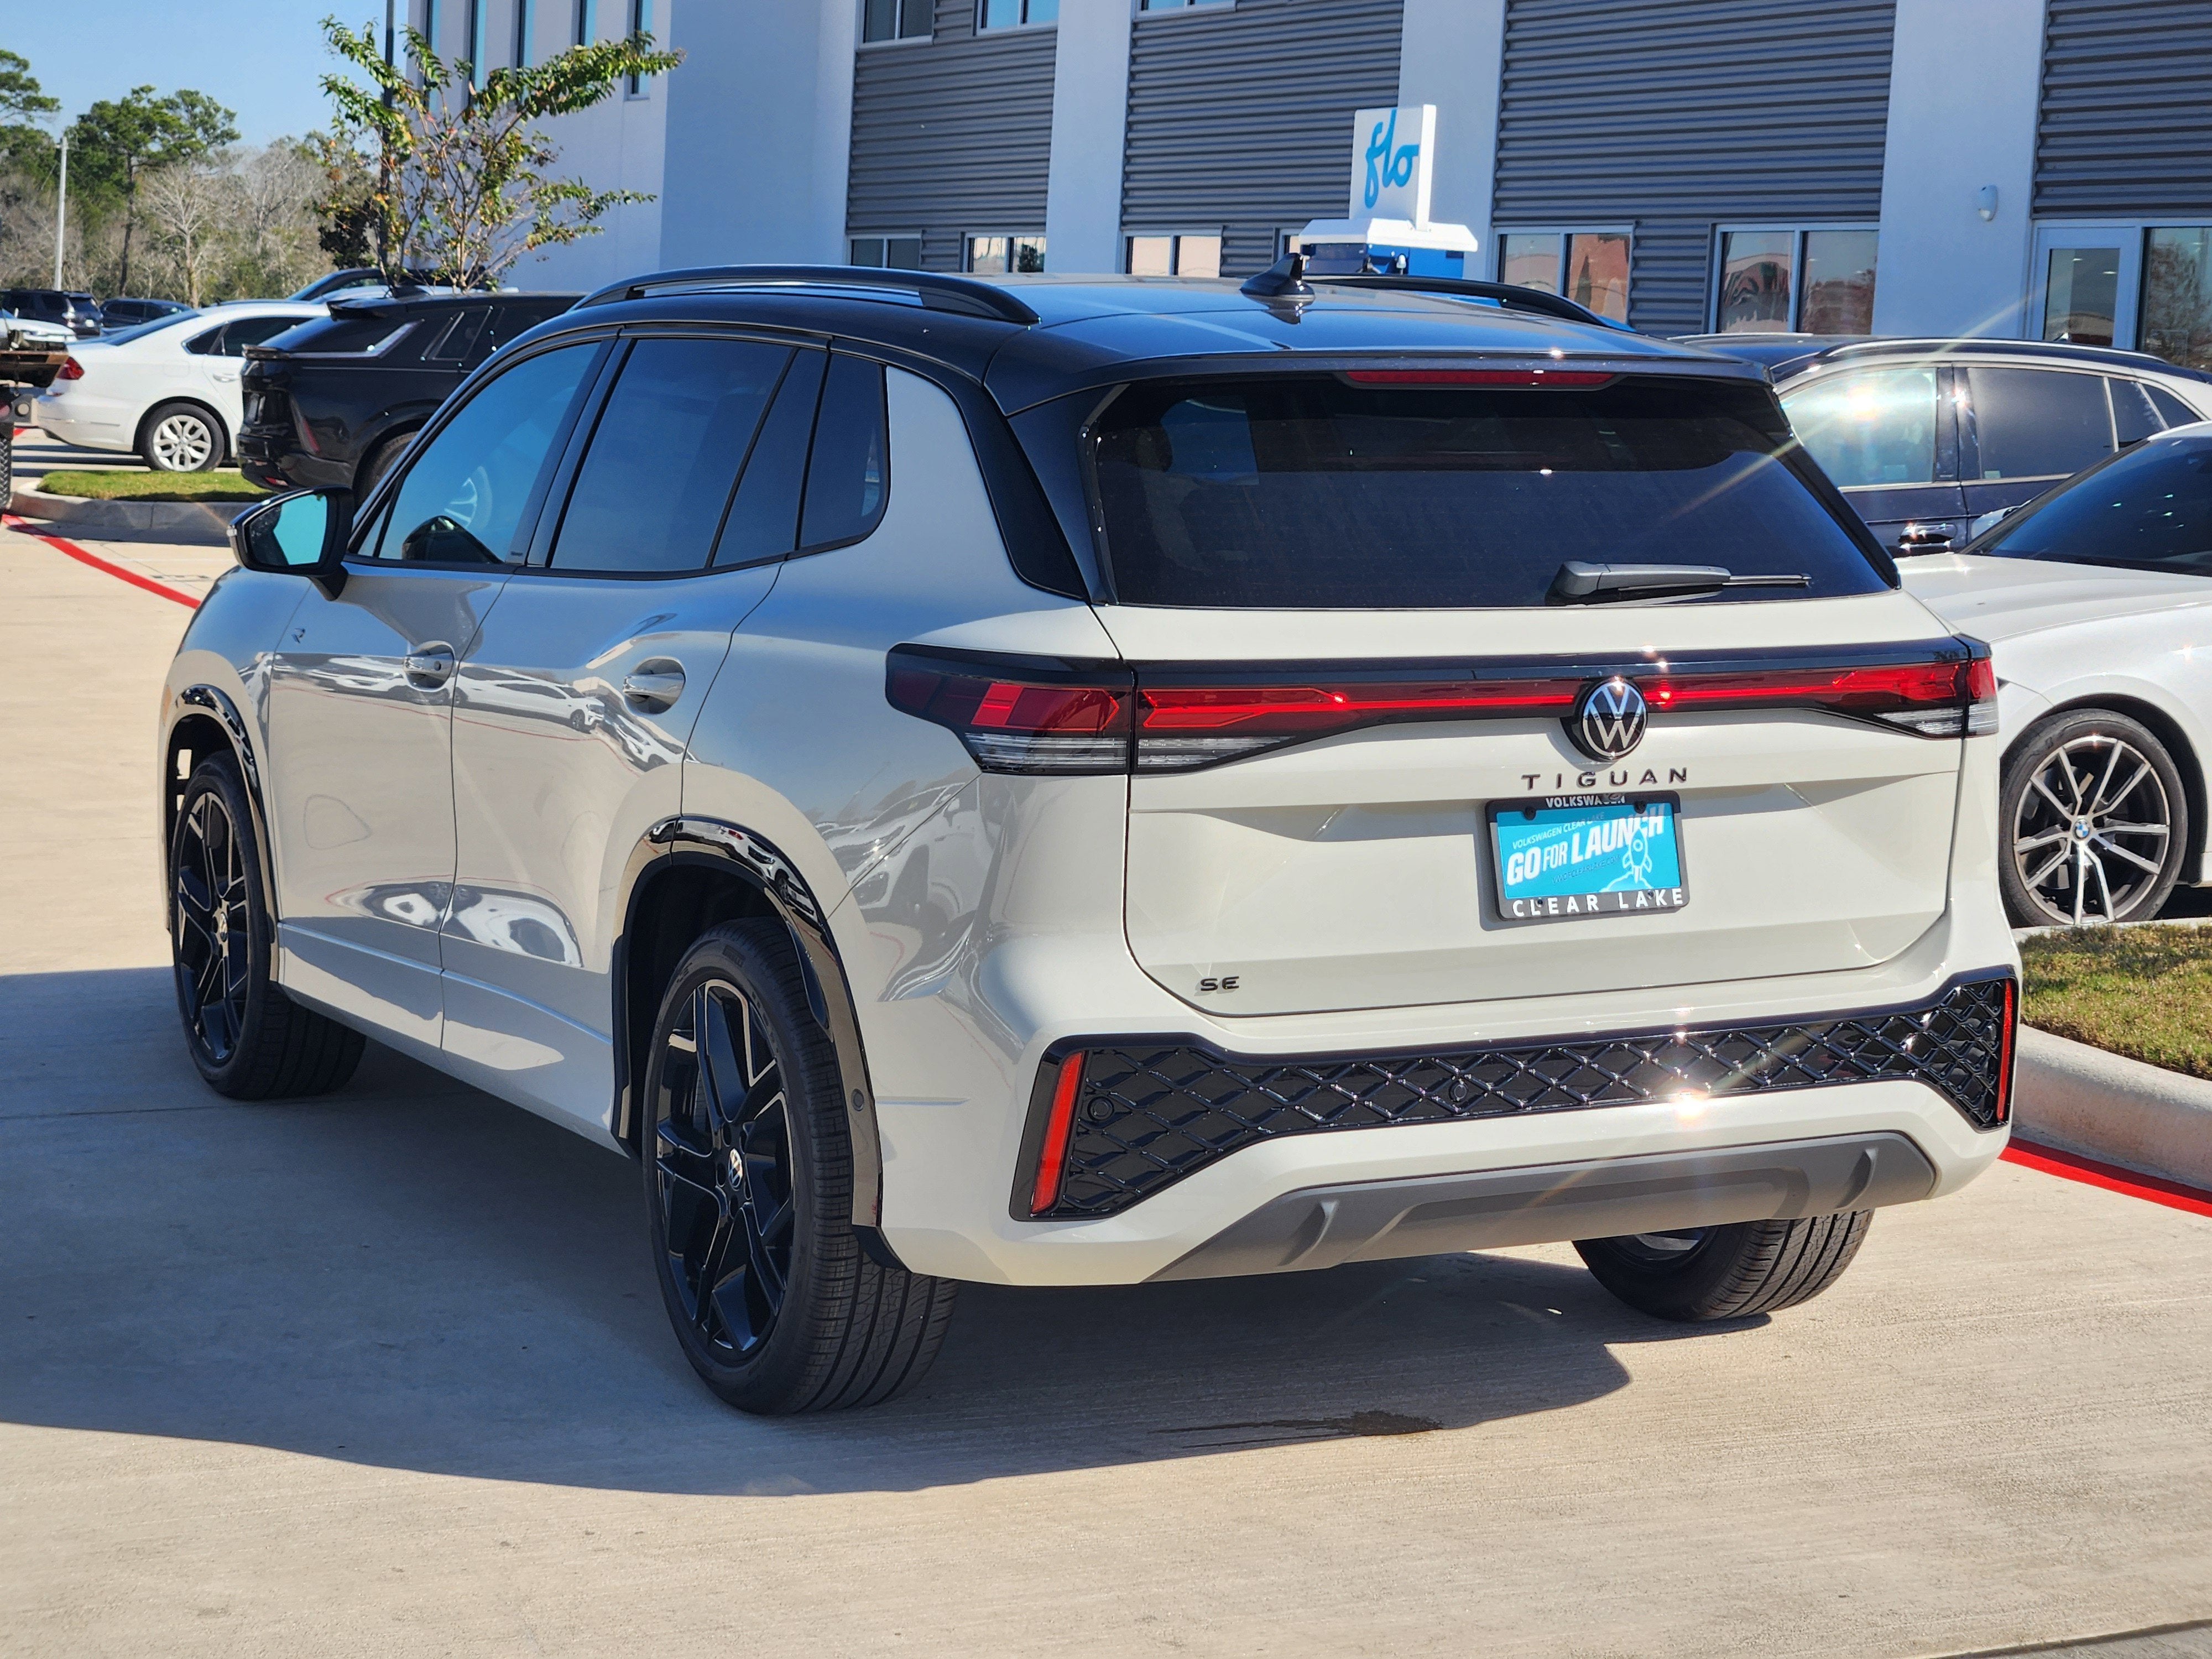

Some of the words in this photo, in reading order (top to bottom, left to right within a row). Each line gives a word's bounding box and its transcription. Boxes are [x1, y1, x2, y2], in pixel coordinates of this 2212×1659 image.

[1364, 109, 1419, 208] flo
[1521, 768, 1687, 790] TIGUAN
[1507, 847, 1541, 886] GO
[1542, 841, 1568, 872] FOR
[1571, 804, 1665, 864] LAUNCH
[1512, 826, 1562, 850] VOLKSWAGEN
[1563, 820, 1586, 833] CLEAR
[1587, 811, 1604, 825] LAKE
[1512, 894, 1599, 917] CLEAR
[1618, 888, 1683, 909] LAKE
[1201, 976, 1239, 992] SE
